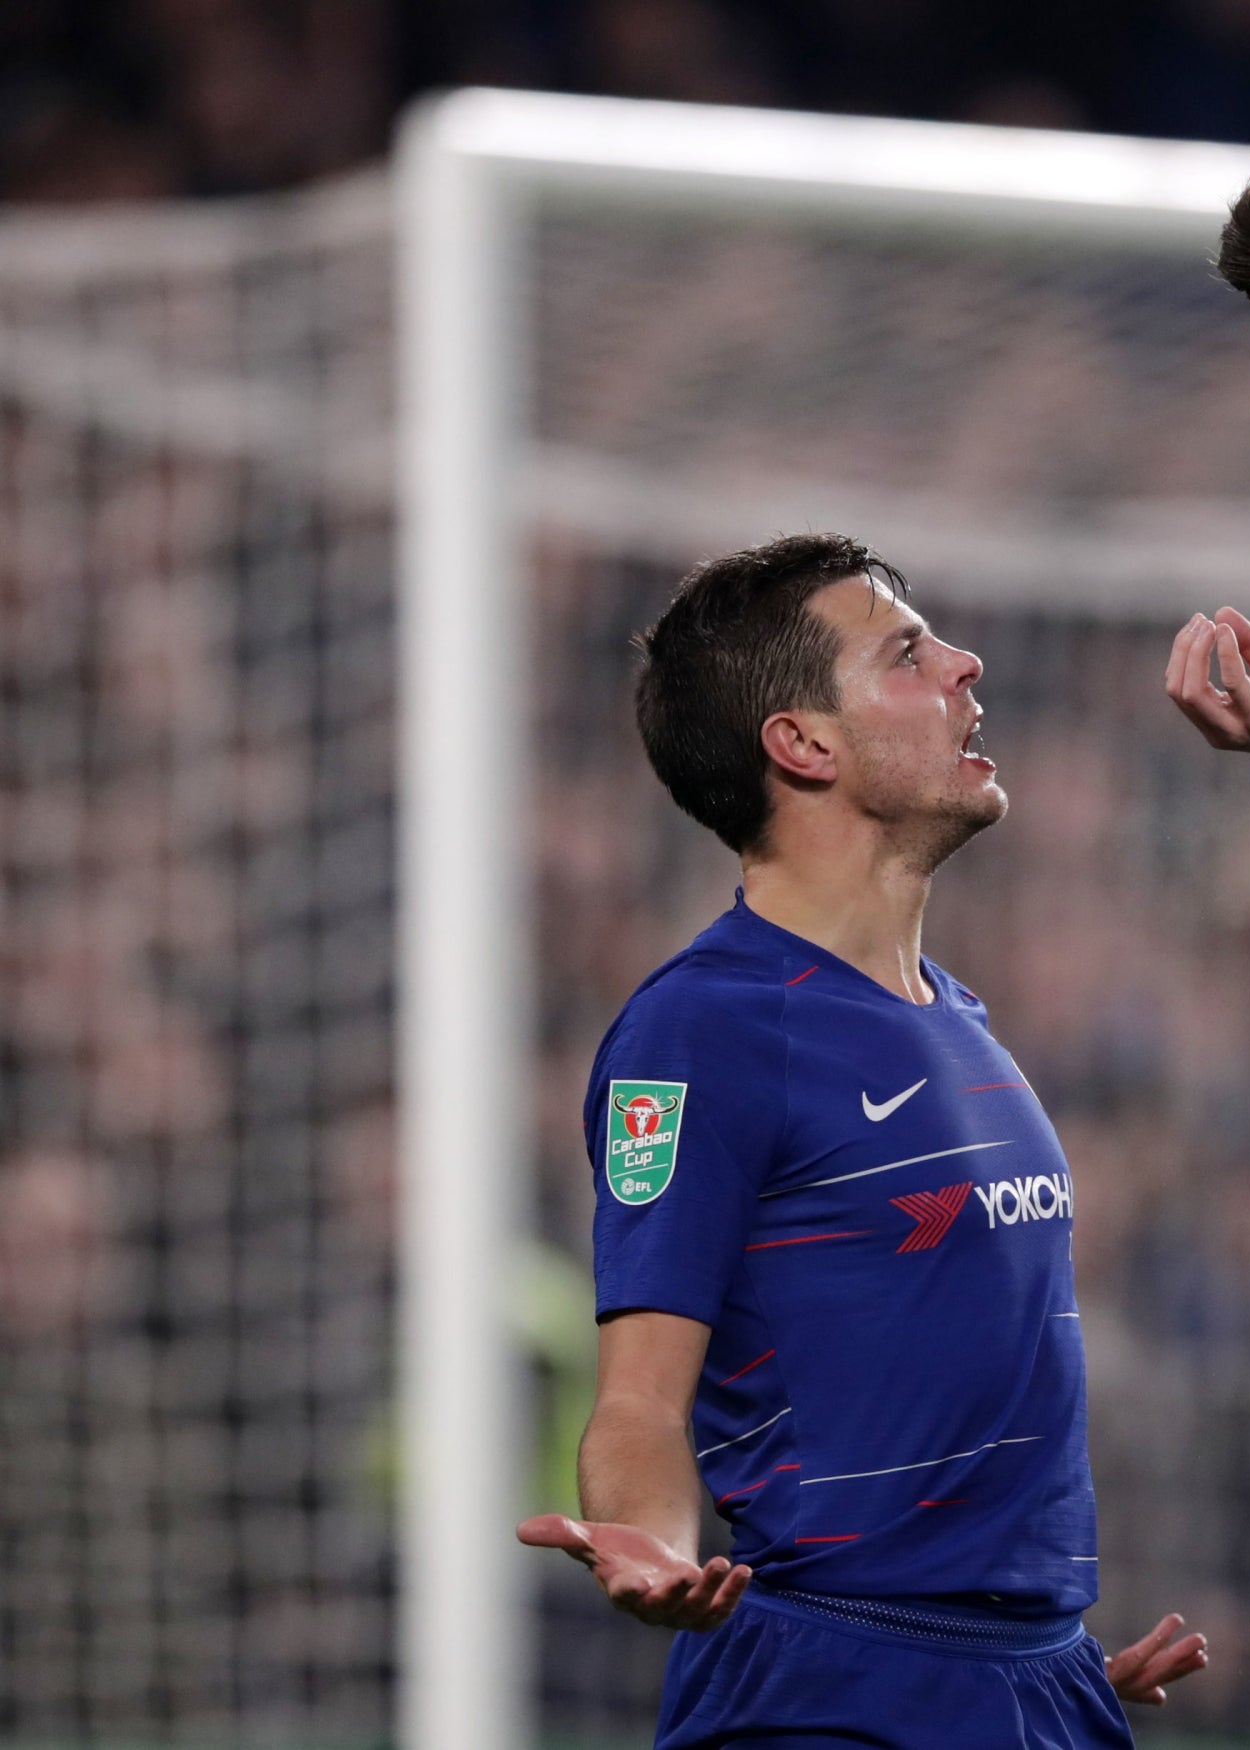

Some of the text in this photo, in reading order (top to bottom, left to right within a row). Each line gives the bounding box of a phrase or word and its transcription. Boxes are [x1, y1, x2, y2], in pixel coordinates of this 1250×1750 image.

[612, 1131, 673, 1155] Carabao
[625, 1151, 653, 1167] Cup
[635, 1182, 652, 1192] EFL
[974, 1173, 1073, 1229] YOKOH
